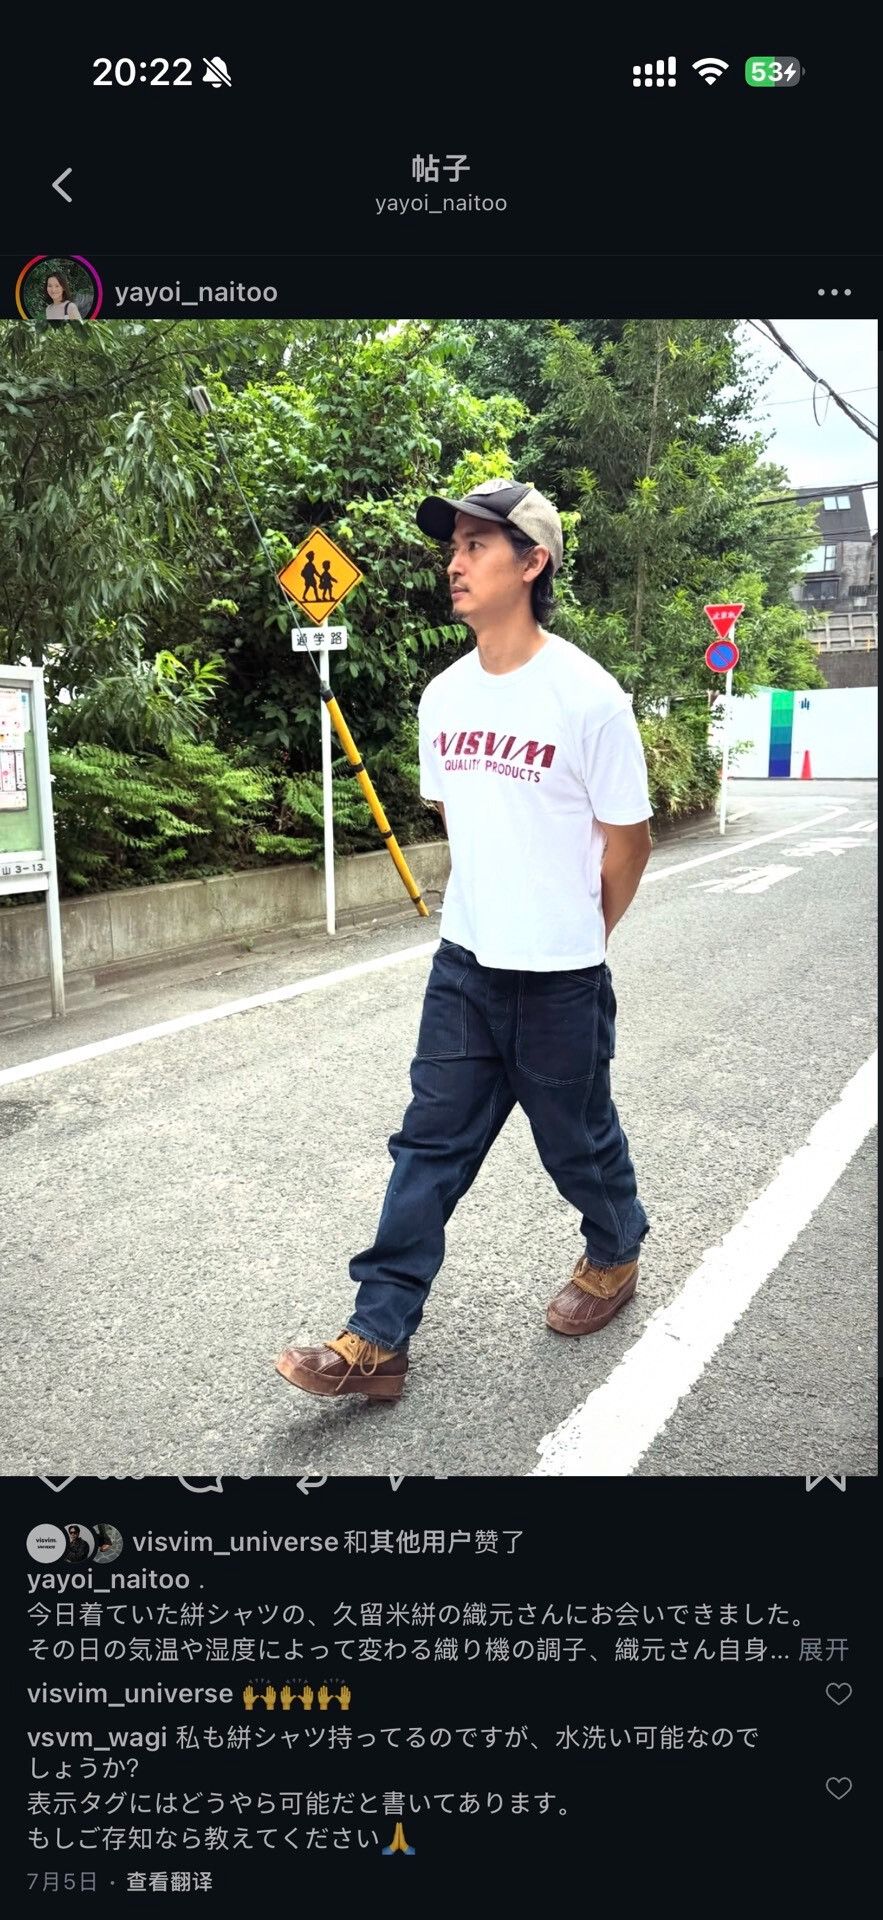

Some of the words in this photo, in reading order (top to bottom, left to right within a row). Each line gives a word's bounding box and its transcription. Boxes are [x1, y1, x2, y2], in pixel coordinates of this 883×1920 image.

[93, 58, 192, 86] 20:22
[751, 61, 783, 82] 53
[412, 154, 470, 182] 帖子
[376, 194, 507, 214] yayoi_naitoo
[115, 281, 277, 306] yayoi_naitoo
[296, 631, 343, 646] 通学路
[433, 730, 556, 769] VISVIM
[444, 759, 480, 772] QUALITY
[485, 760, 542, 783] PRODUCTS
[27, 1568, 189, 1593] yayoi_naitoo
[28, 1602, 802, 1627] 今日着ていた絣シャツの、久留米絣の織元さんにお会いできました。
[799, 1637, 849, 1662] 展开
[27, 1682, 234, 1707] visvim_universe
[27, 1726, 166, 1751] vsvm_wagi
[176, 1725, 759, 1750] 私も絣シャツ持ってるのですが、水洗い可能なので
[32, 1757, 138, 1780] しょうか?
[28, 1791, 568, 1816] 表示タグにはどうやら可能だと書いてあります。
[29, 1826, 379, 1851] もしご存知なら教えてください
[27, 1871, 96, 1892] 7月5日
[127, 1871, 213, 1893] 查看翻译
